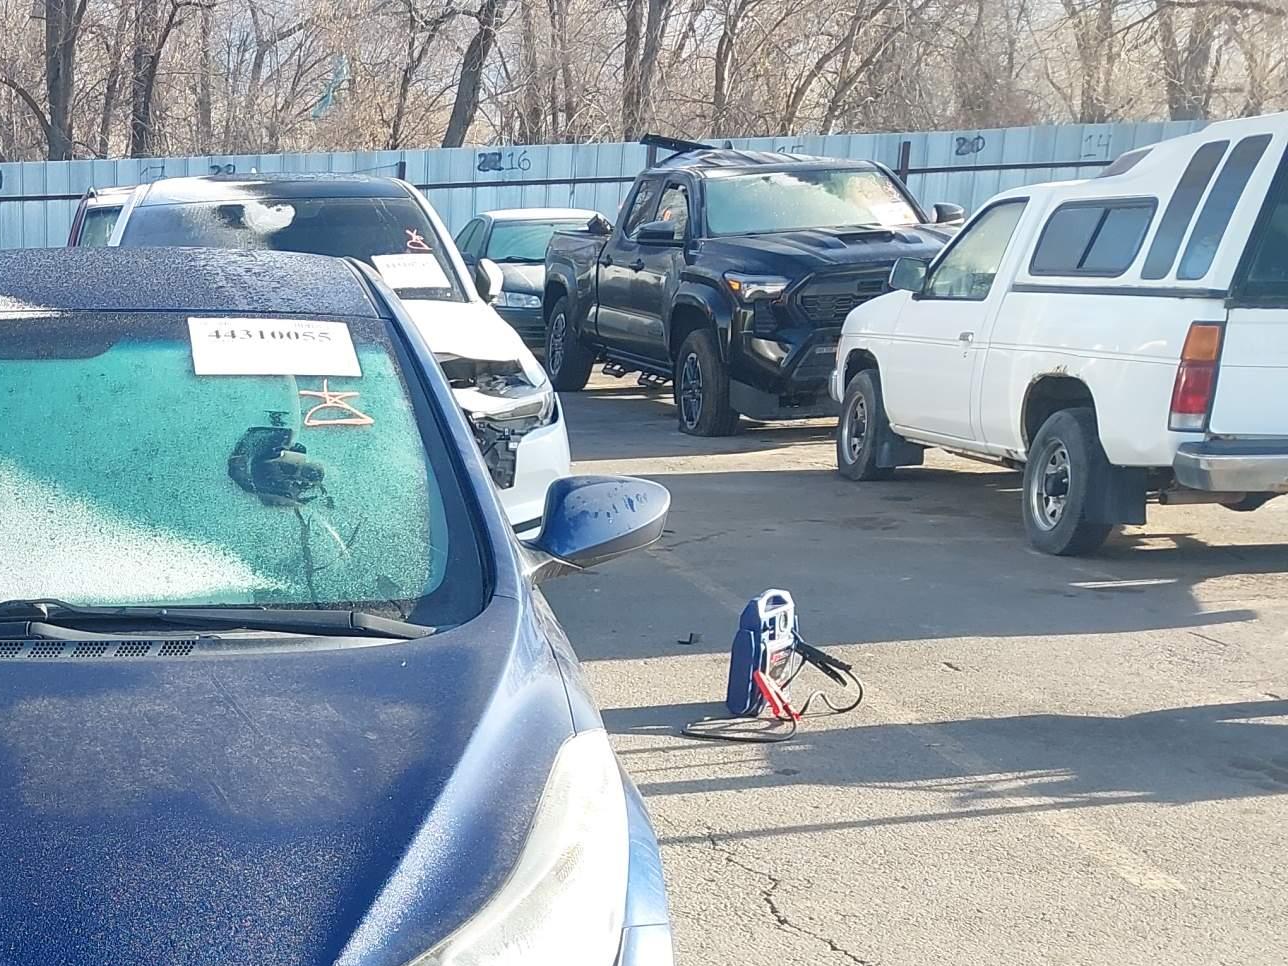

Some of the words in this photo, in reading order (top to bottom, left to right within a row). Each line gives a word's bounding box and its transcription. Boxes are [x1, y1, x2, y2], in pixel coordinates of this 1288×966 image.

[955, 136, 985, 155] 20
[1083, 134, 1112, 157] 14
[505, 150, 531, 171] 16
[207, 328, 332, 342] 44310055
